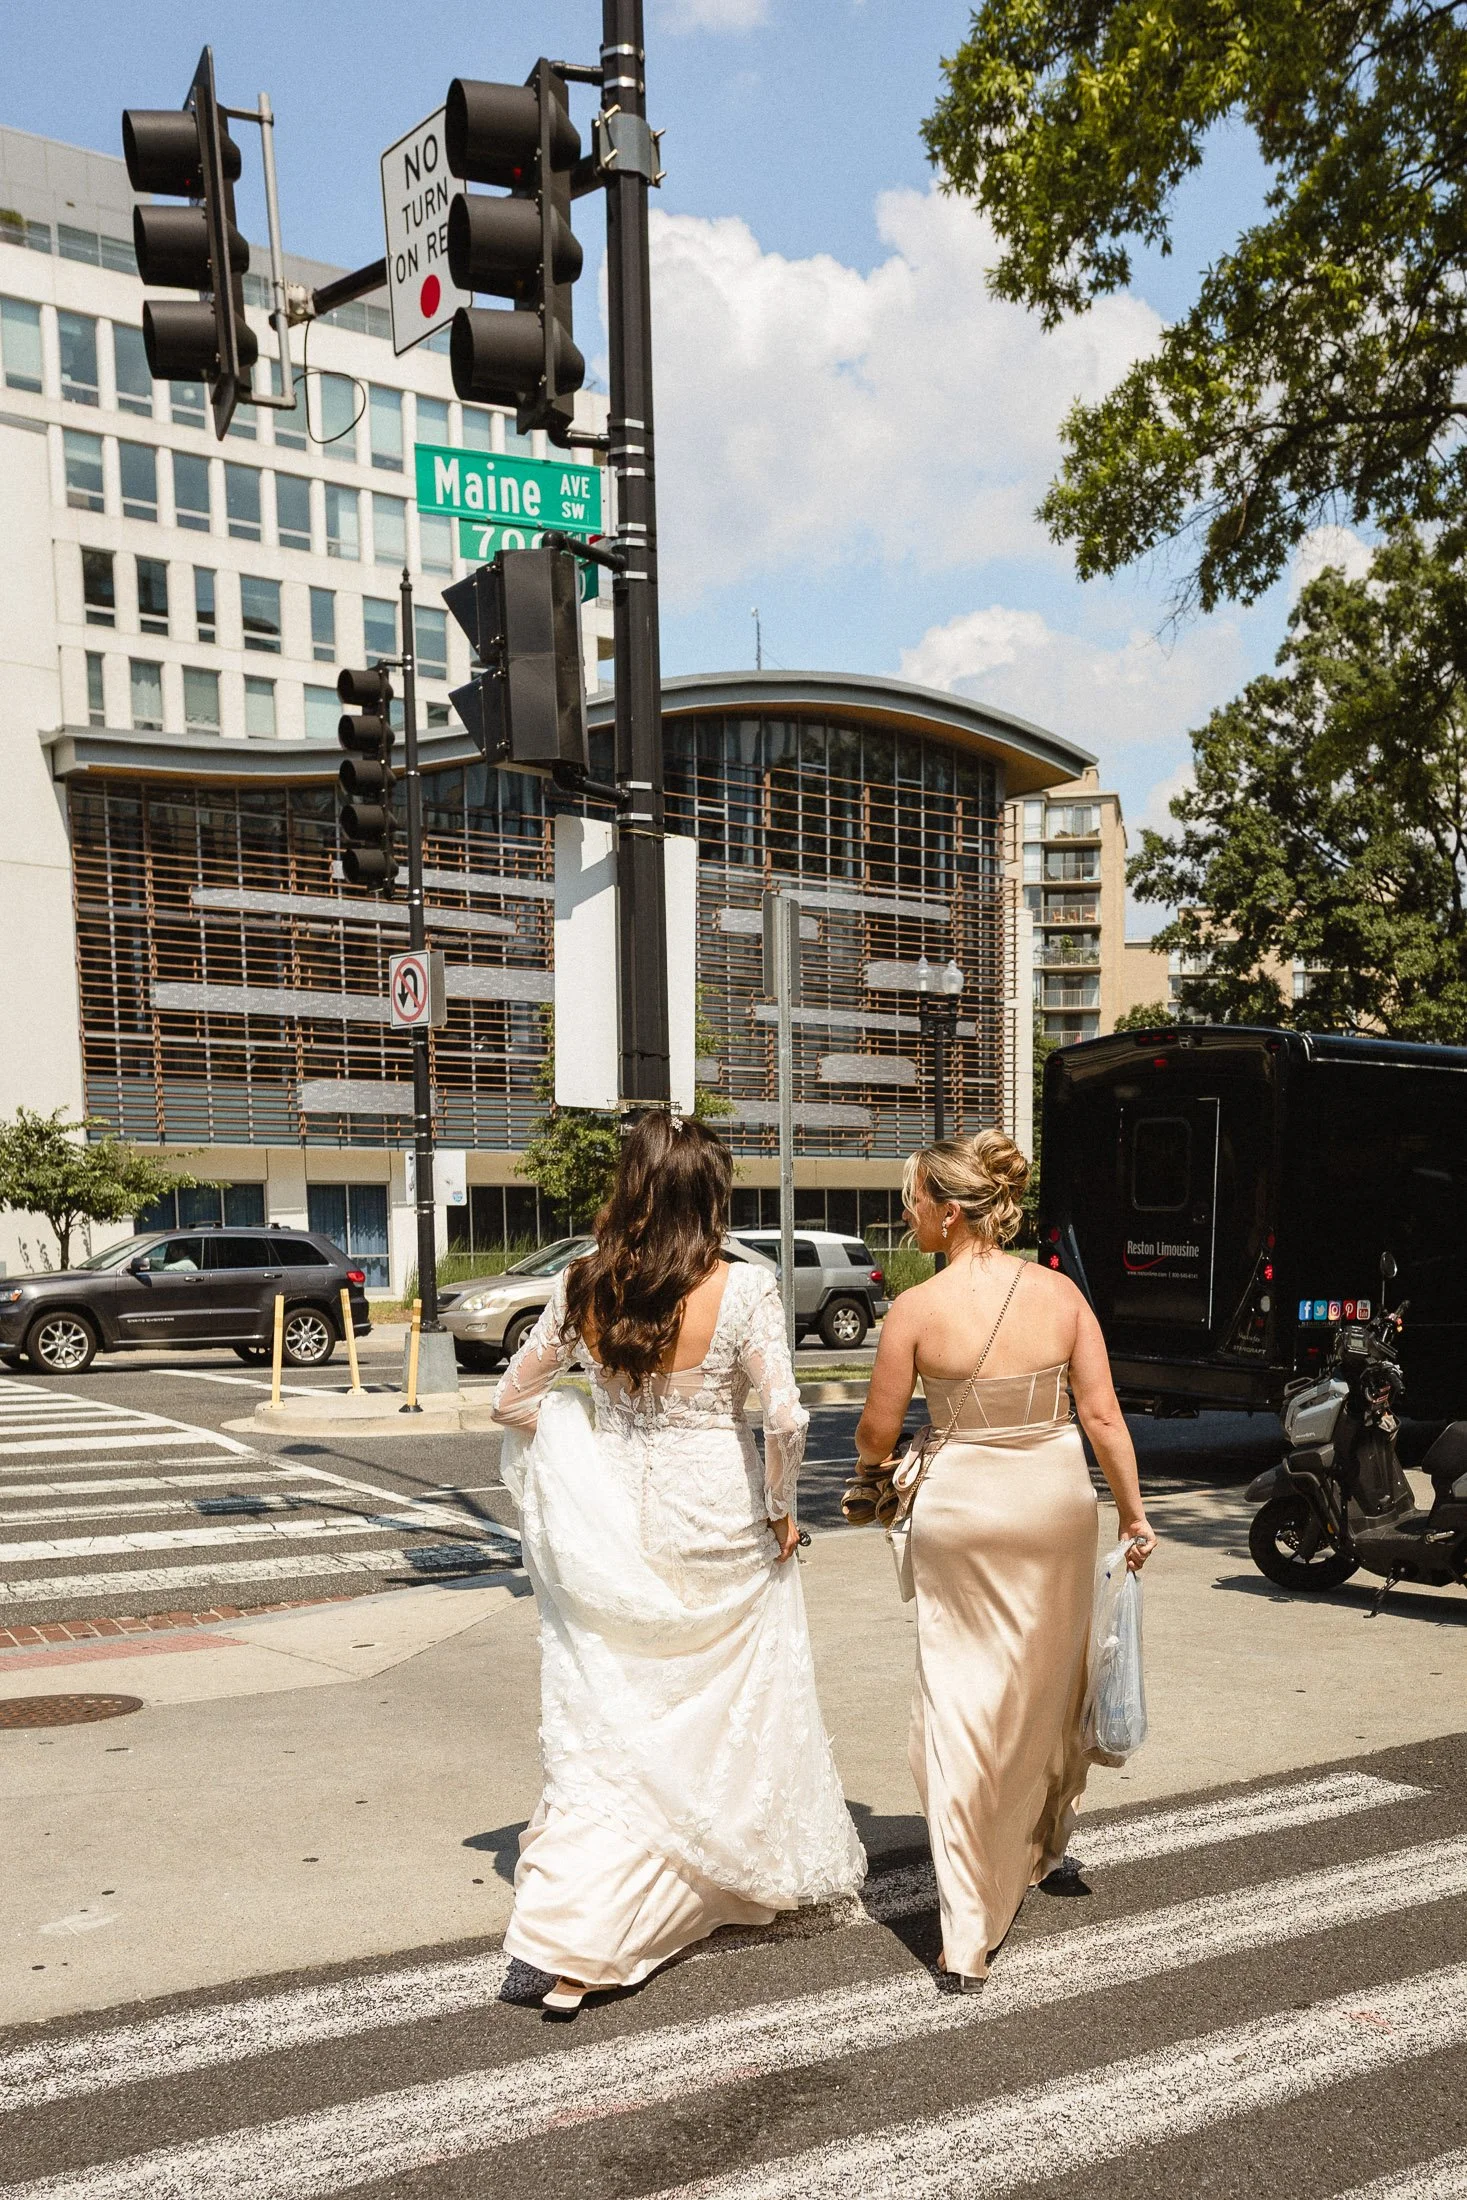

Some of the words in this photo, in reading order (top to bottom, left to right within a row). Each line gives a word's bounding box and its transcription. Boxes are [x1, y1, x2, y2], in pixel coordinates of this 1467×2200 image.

[403, 133, 438, 190] NO
[402, 176, 448, 234] TURN
[396, 243, 419, 284] ON
[427, 222, 448, 264] RE
[434, 456, 541, 517] Maine
[560, 473, 591, 499] AVE
[561, 501, 585, 520] SW
[1127, 1240, 1155, 1255] Reston
[1157, 1240, 1200, 1258] Limousine
